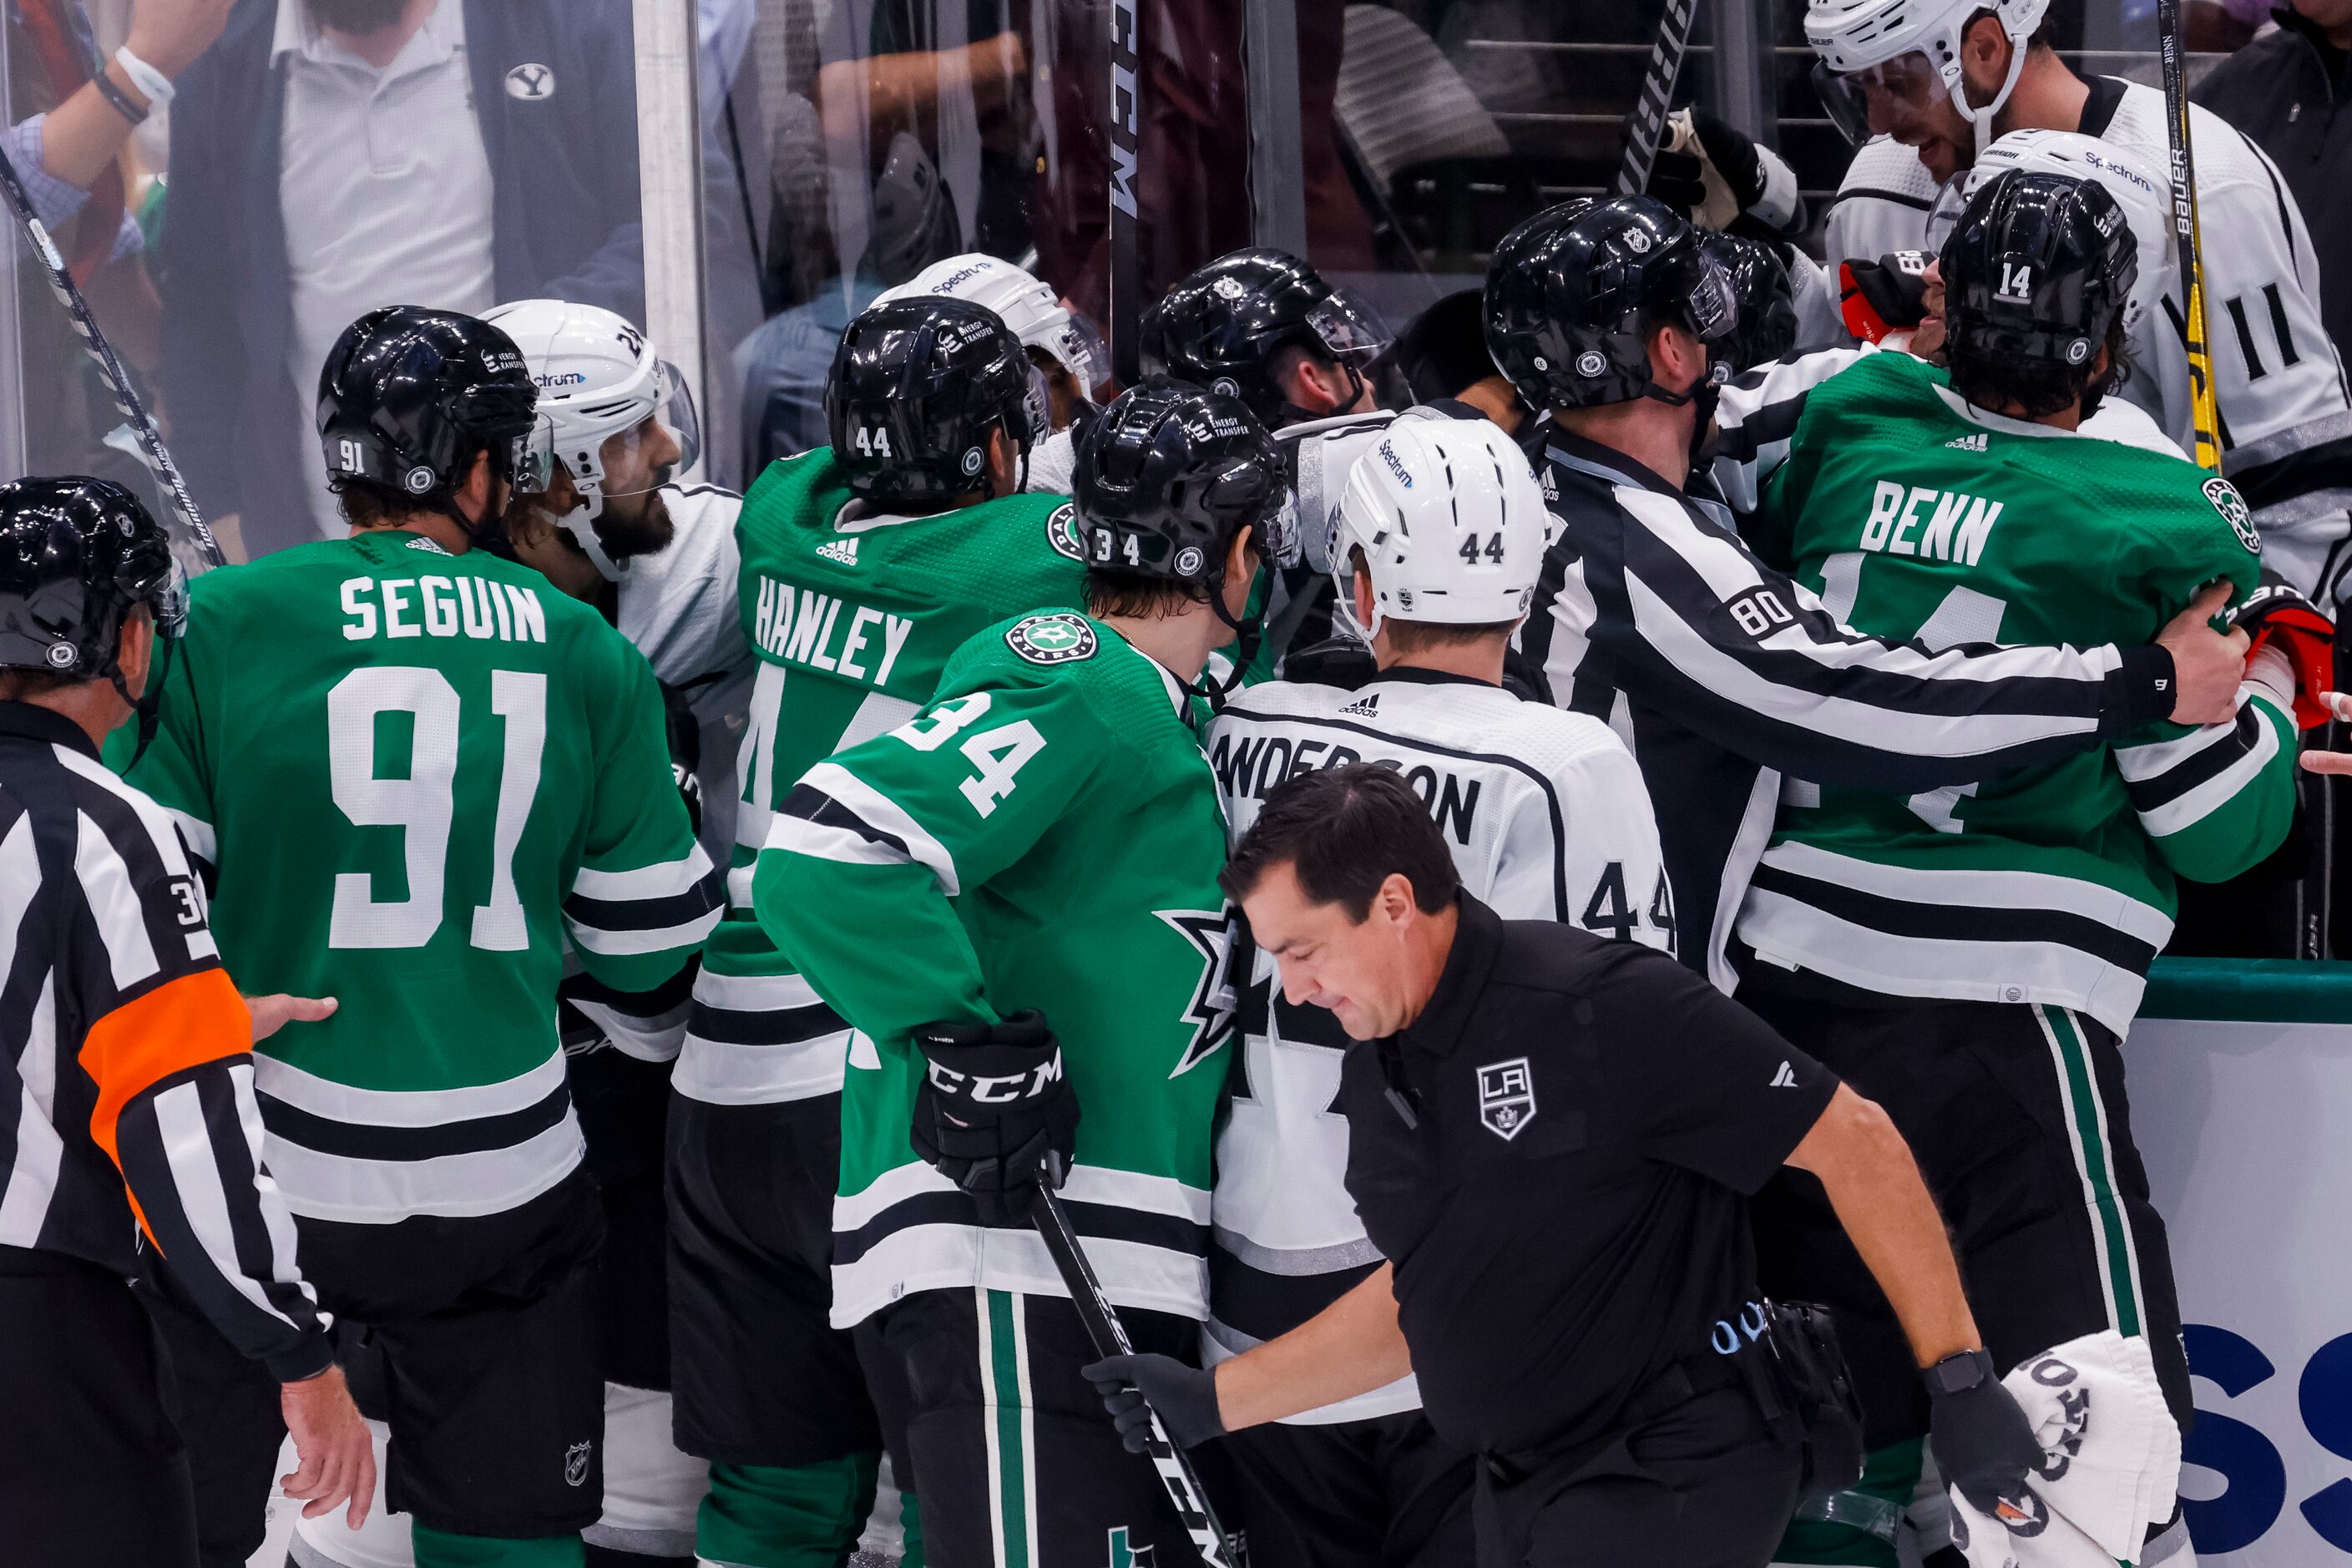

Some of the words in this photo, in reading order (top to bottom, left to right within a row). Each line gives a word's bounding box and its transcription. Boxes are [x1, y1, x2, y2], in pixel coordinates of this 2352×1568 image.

[2163, 34, 2174, 64] BENN
[2086, 151, 2150, 191] Spectrum
[932, 261, 991, 293] Spectrum
[2000, 262, 2031, 297] 14
[964, 326, 994, 344] TRANSFER
[2225, 282, 2300, 382] 11
[1211, 417, 1238, 429] ENERGY
[1215, 425, 1250, 438] TRANSFER
[340, 439, 364, 473] 91
[855, 426, 891, 458] 44
[1378, 438, 1412, 488] Spectrum
[1859, 480, 2004, 567] BENN
[815, 544, 858, 566] adidas
[1458, 532, 1505, 564] 44
[340, 574, 547, 643] SEGUIN
[1729, 590, 1794, 636] 80
[755, 575, 913, 685] HANLEY
[1017, 616, 1093, 645] DALLAS
[1012, 635, 1080, 660] STARS
[1338, 701, 1378, 720] adidas
[887, 691, 1048, 820] 34
[327, 665, 548, 952] 91
[928, 1045, 1063, 1104] CCM
[1483, 1068, 1527, 1099] LA
[1095, 1286, 1136, 1356] CC
